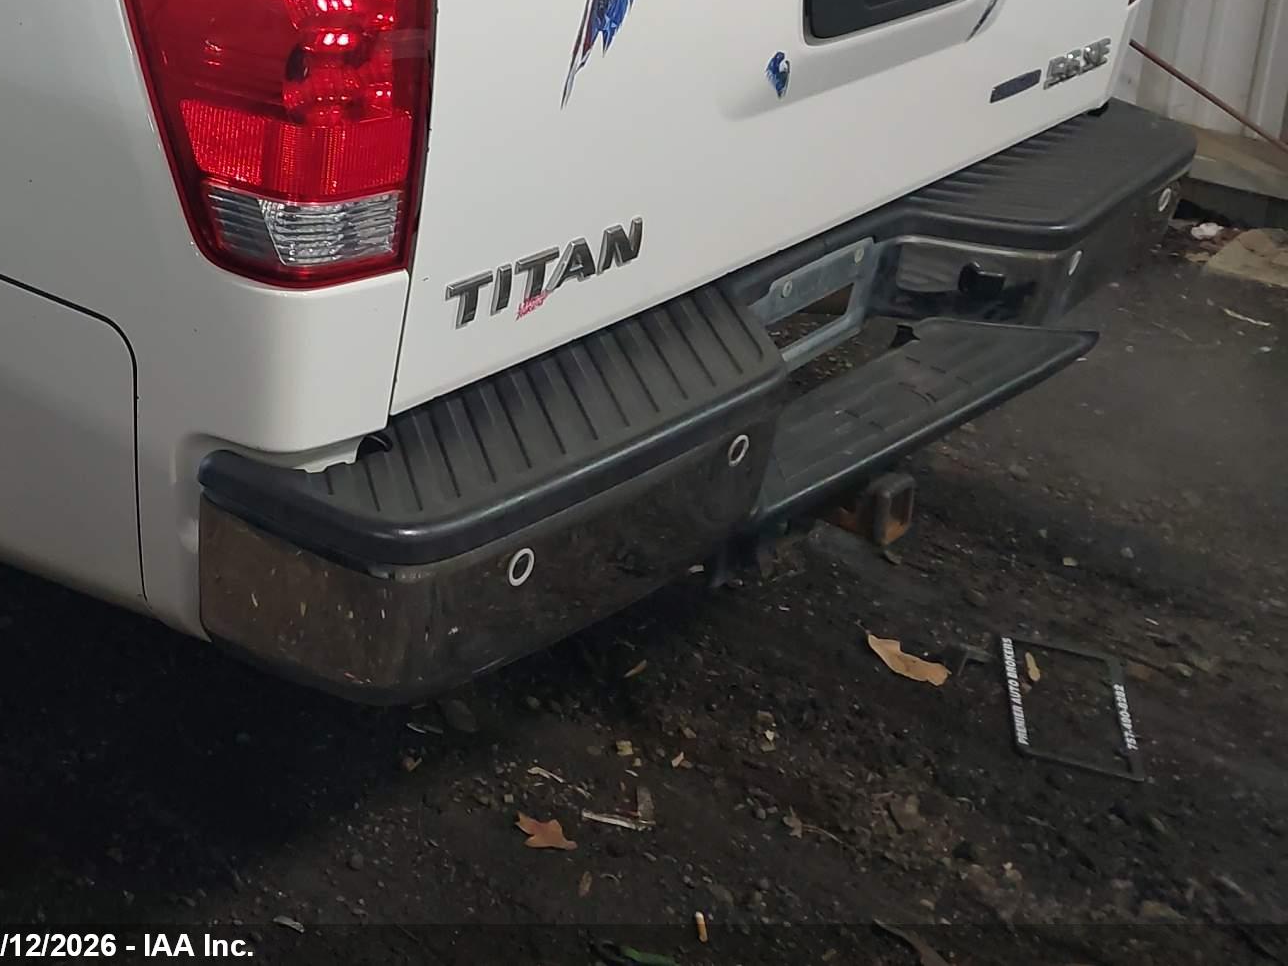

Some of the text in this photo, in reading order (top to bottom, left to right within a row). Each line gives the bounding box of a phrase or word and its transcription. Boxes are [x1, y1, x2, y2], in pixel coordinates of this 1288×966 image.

[445, 215, 644, 330] TITAN
[1000, 636, 1029, 746] PREMIER AUTO BROKERS
